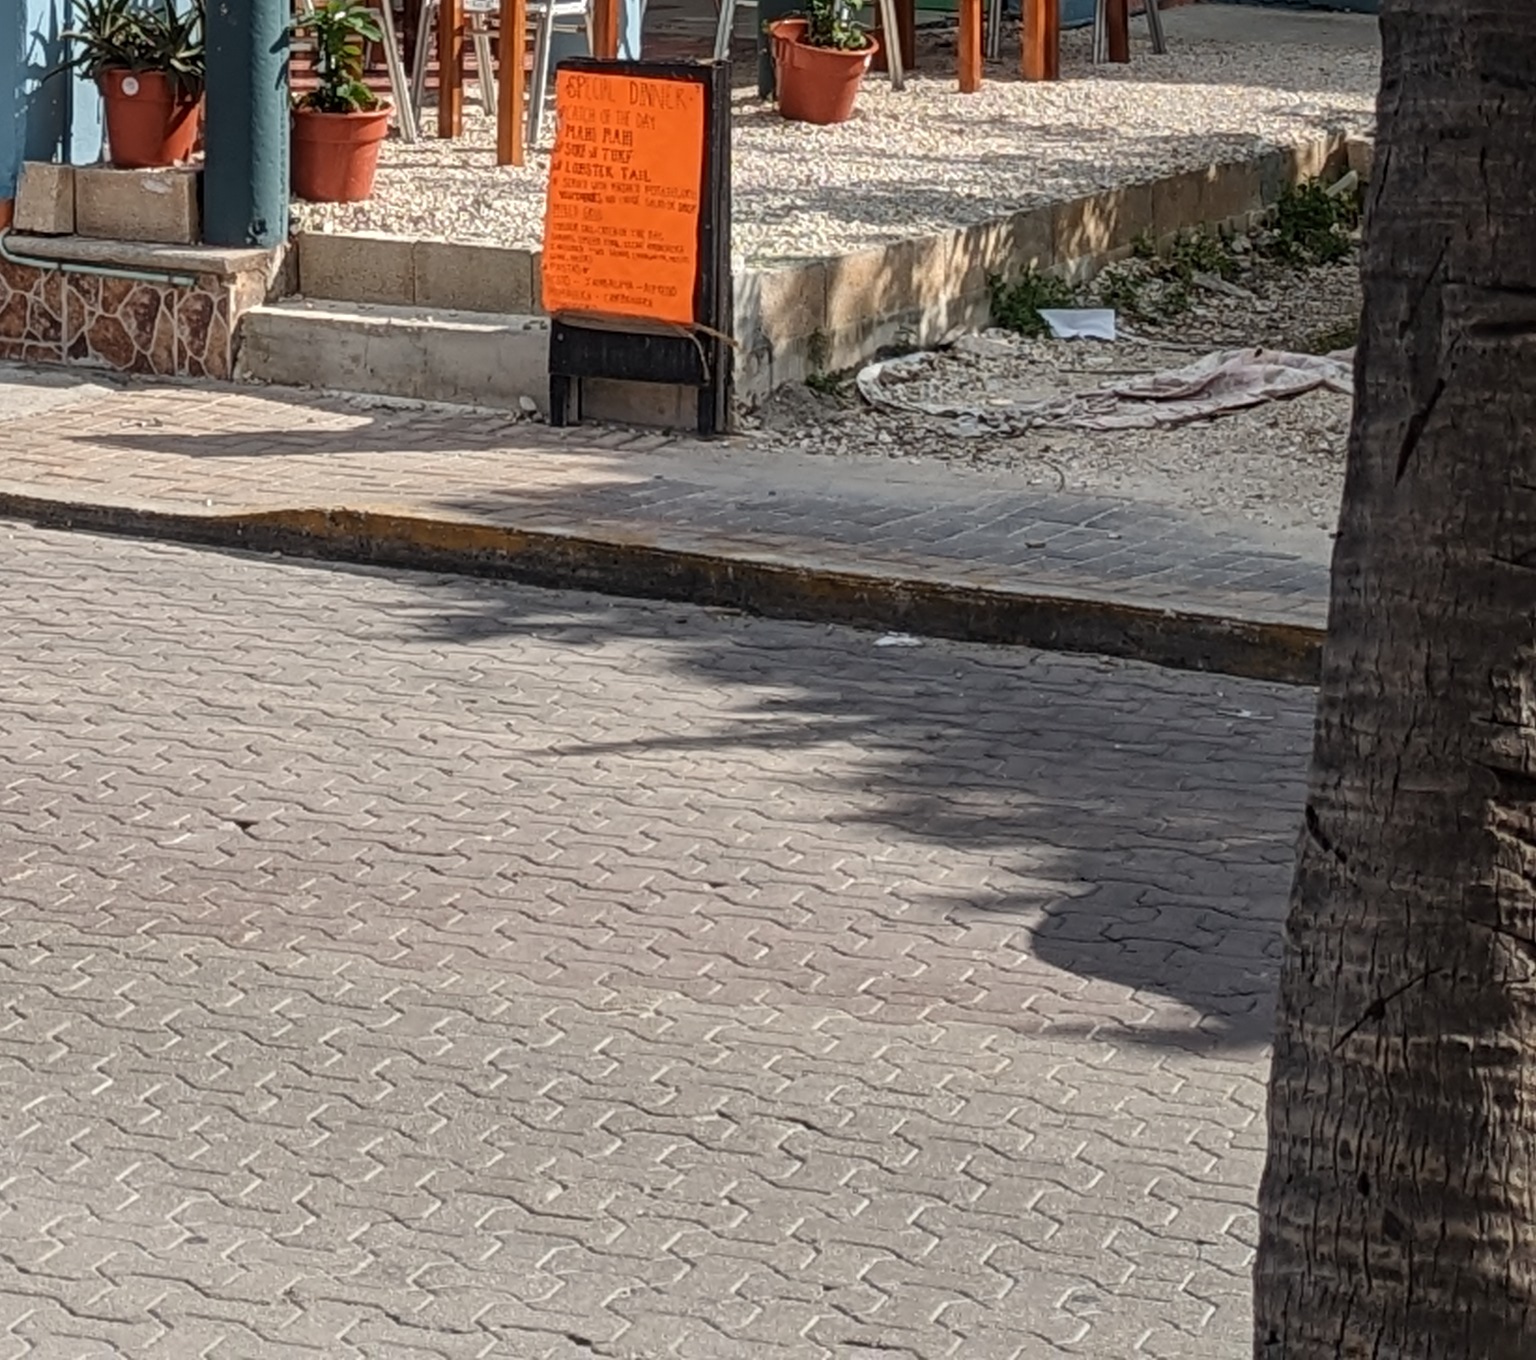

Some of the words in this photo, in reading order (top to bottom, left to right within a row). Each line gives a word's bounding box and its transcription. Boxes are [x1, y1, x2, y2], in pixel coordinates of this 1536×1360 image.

[565, 105, 596, 123] CATCH
[600, 108, 611, 125] OF
[616, 110, 631, 127] THE
[635, 112, 656, 130] DAY
